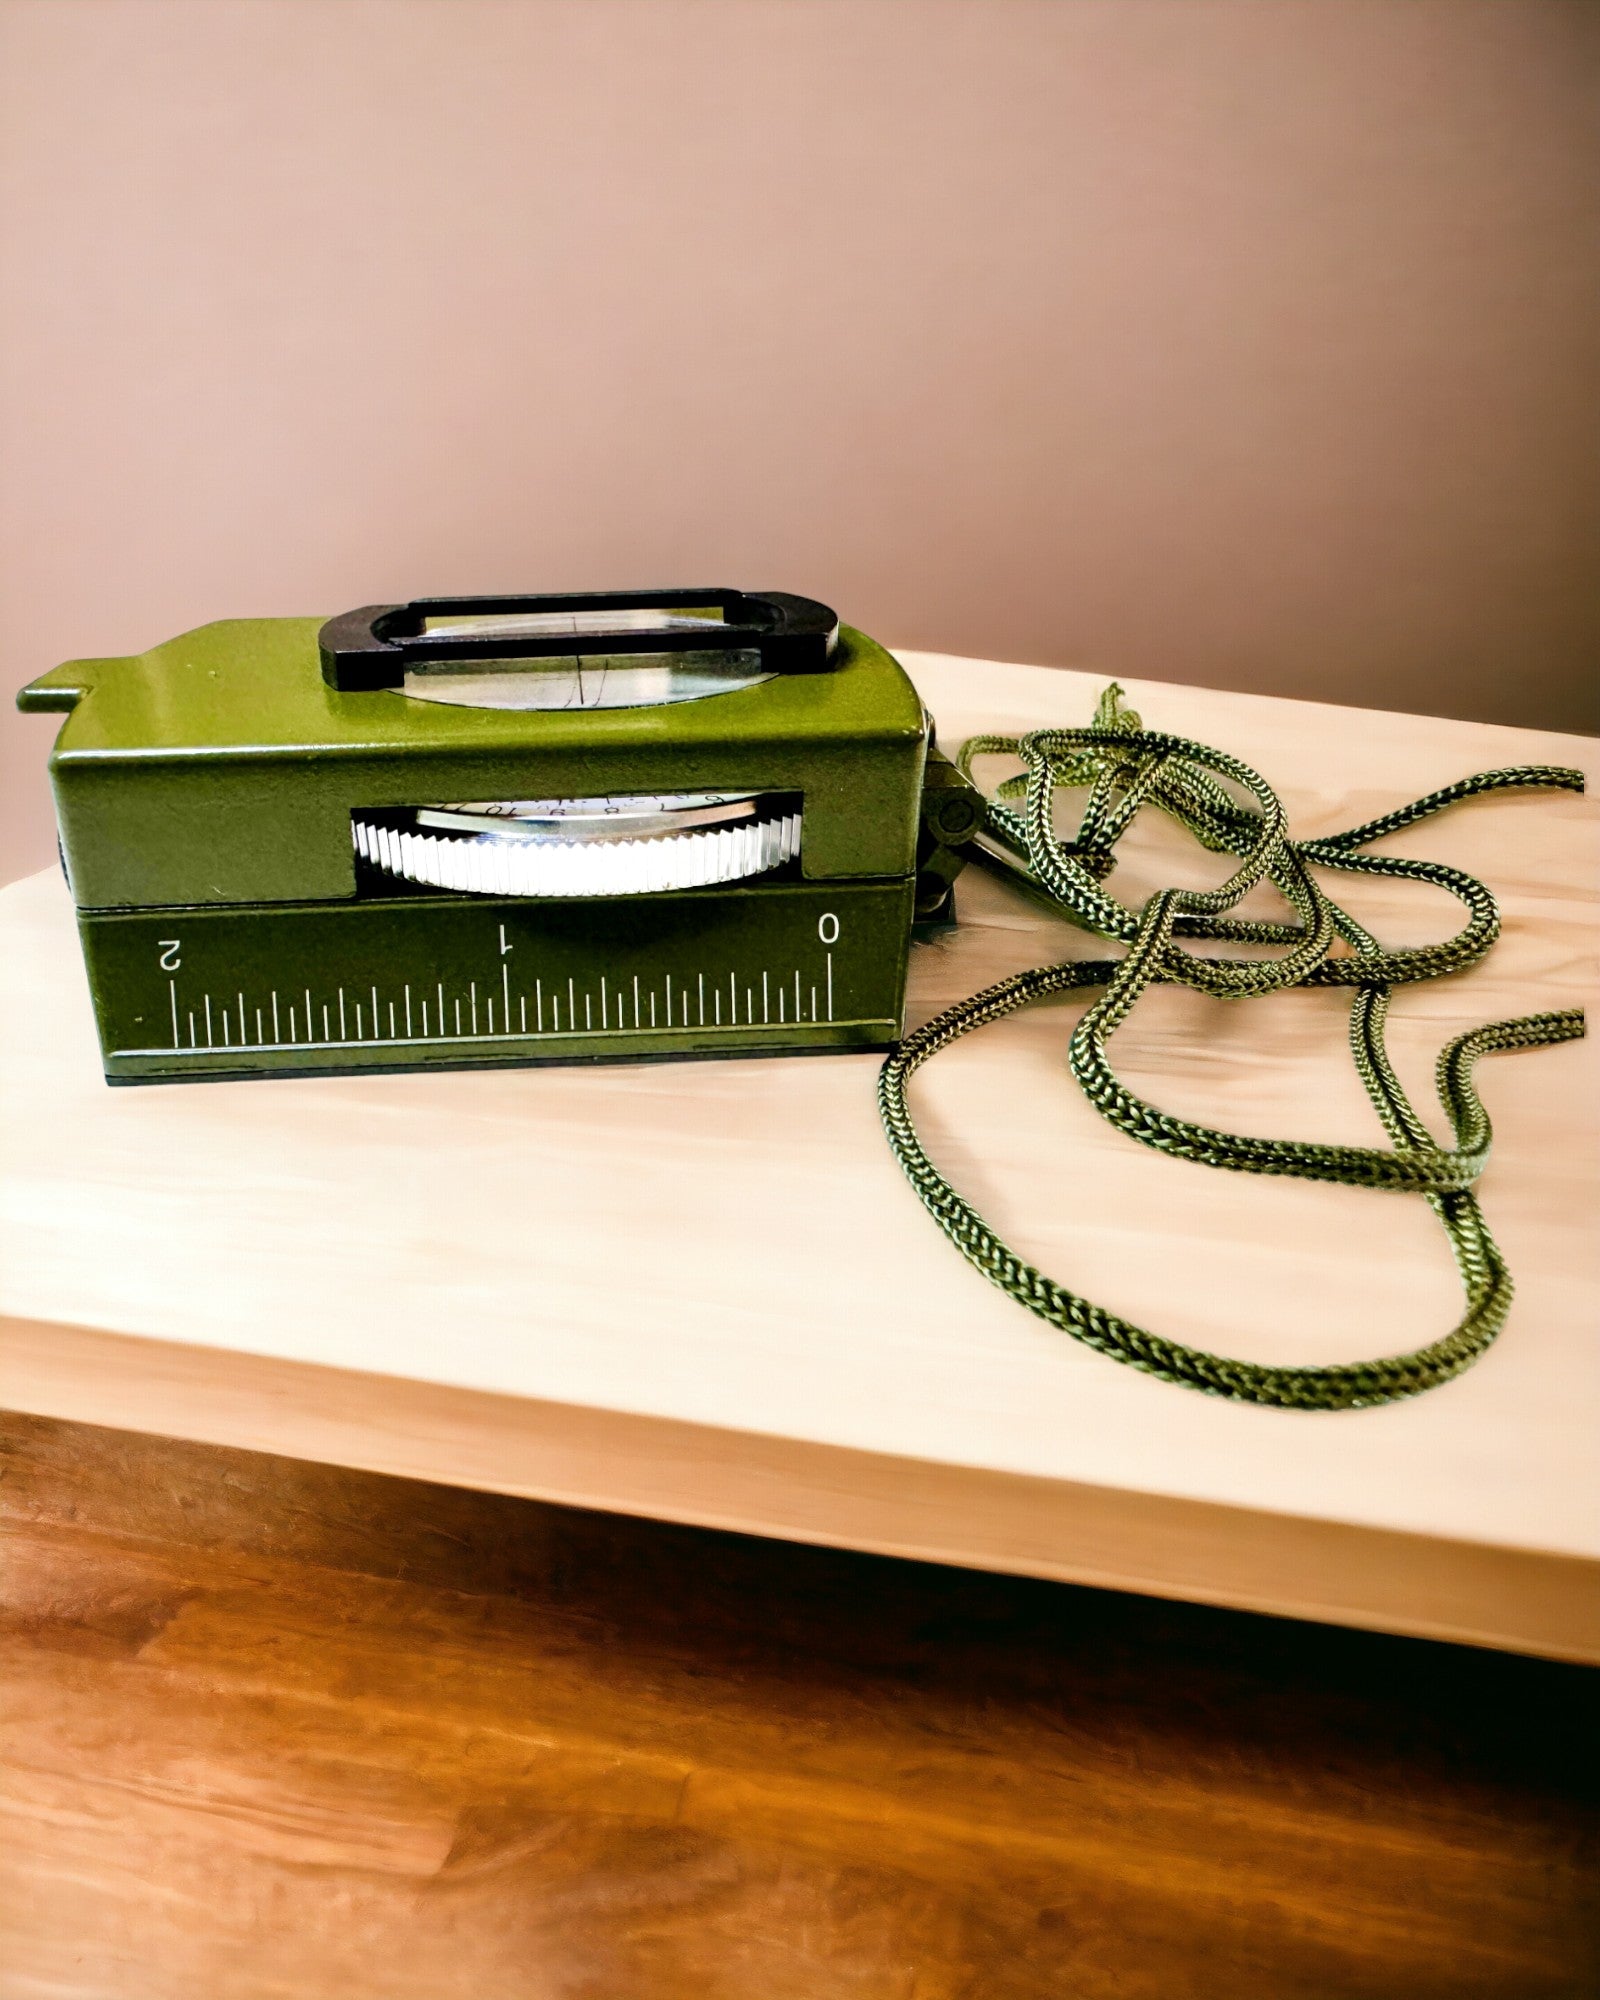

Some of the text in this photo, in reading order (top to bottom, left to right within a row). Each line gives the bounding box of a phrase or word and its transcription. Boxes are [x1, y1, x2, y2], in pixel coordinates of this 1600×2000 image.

[157, 912, 840, 972] 0 1 2
